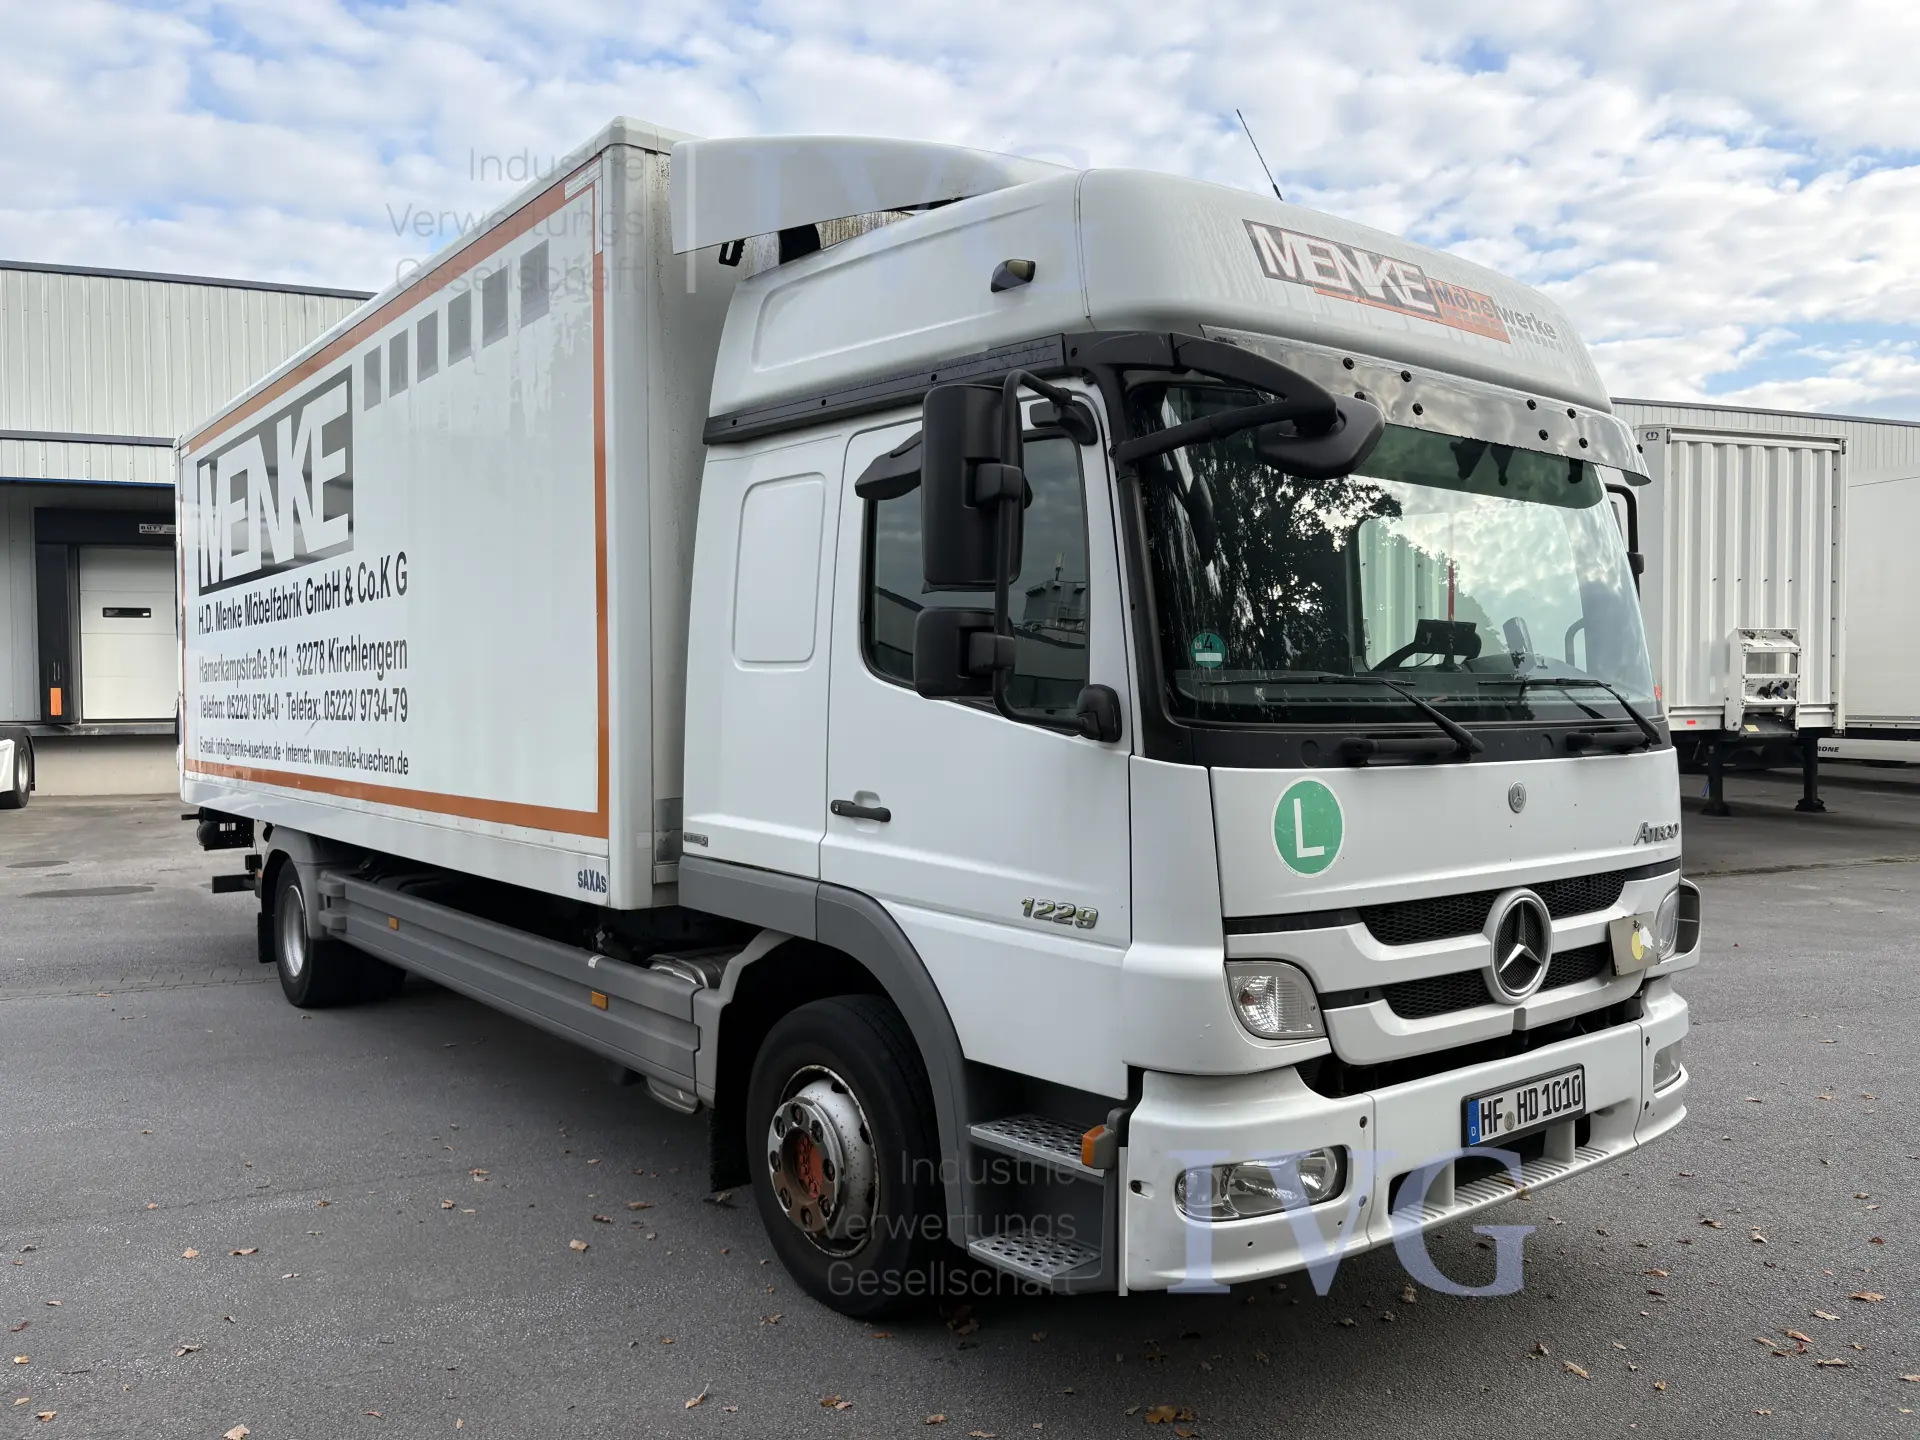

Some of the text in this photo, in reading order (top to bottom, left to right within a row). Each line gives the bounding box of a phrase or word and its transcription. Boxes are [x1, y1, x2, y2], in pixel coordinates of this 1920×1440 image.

[1249, 223, 1439, 315] MENKE
[199, 380, 349, 588] MENKE
[198, 605, 214, 635] H.D.
[215, 600, 243, 632] Menke
[244, 582, 302, 627] Möbelfabrik
[305, 569, 341, 615] GmbH
[344, 565, 354, 607] &
[270, 645, 288, 679] 8-11
[296, 639, 325, 678] 32278
[328, 634, 408, 681] Kirchlengern
[1203, 634, 1213, 651] 4
[199, 694, 226, 720] Telefon:
[252, 692, 280, 721] 9734-0
[286, 690, 321, 721] Telefax:
[360, 686, 408, 723] 9734-79
[285, 741, 312, 764] Internet:
[313, 746, 409, 776] www.menke-kuechen.de
[1293, 797, 1325, 859] L
[577, 868, 607, 894] SAXAS
[1020, 896, 1099, 930] 1229
[1471, 1126, 1477, 1137] D
[1480, 1096, 1504, 1137] HF
